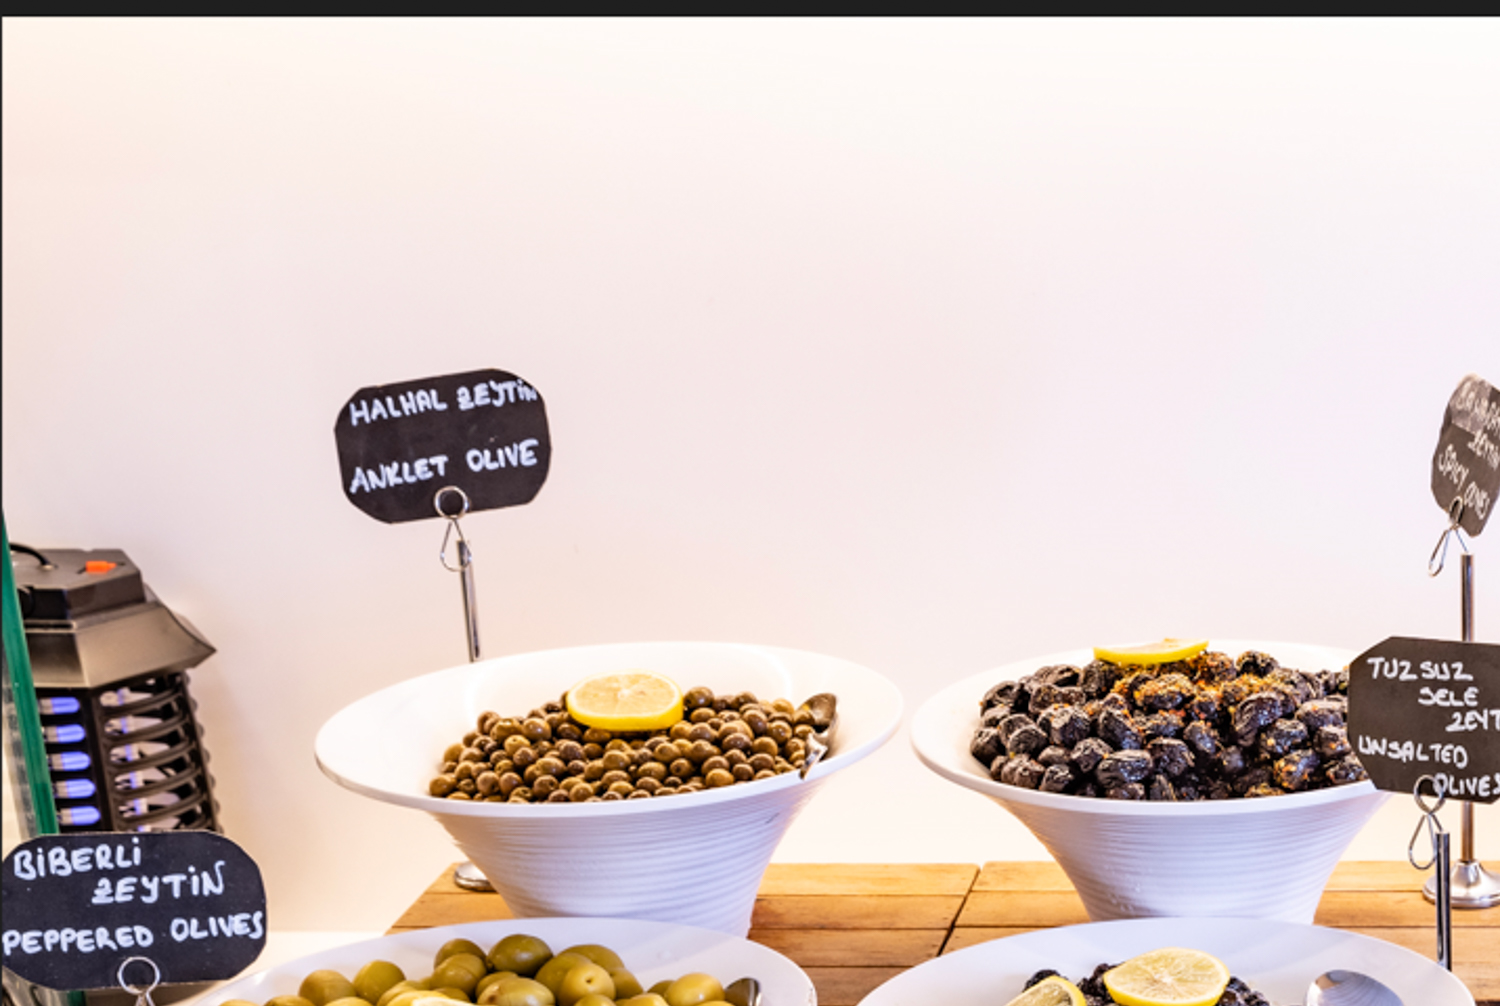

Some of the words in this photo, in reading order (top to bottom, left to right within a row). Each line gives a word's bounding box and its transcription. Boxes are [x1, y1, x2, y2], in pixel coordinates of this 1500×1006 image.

[350, 389, 448, 426] HALHAL
[350, 455, 449, 494] ANKLET
[466, 438, 539, 472] OLIVE
[1418, 685, 1479, 707] SELE
[1358, 735, 1468, 769] UNSALTED
[2, 925, 154, 956] PEPPERED
[170, 910, 263, 943] OLIVES
